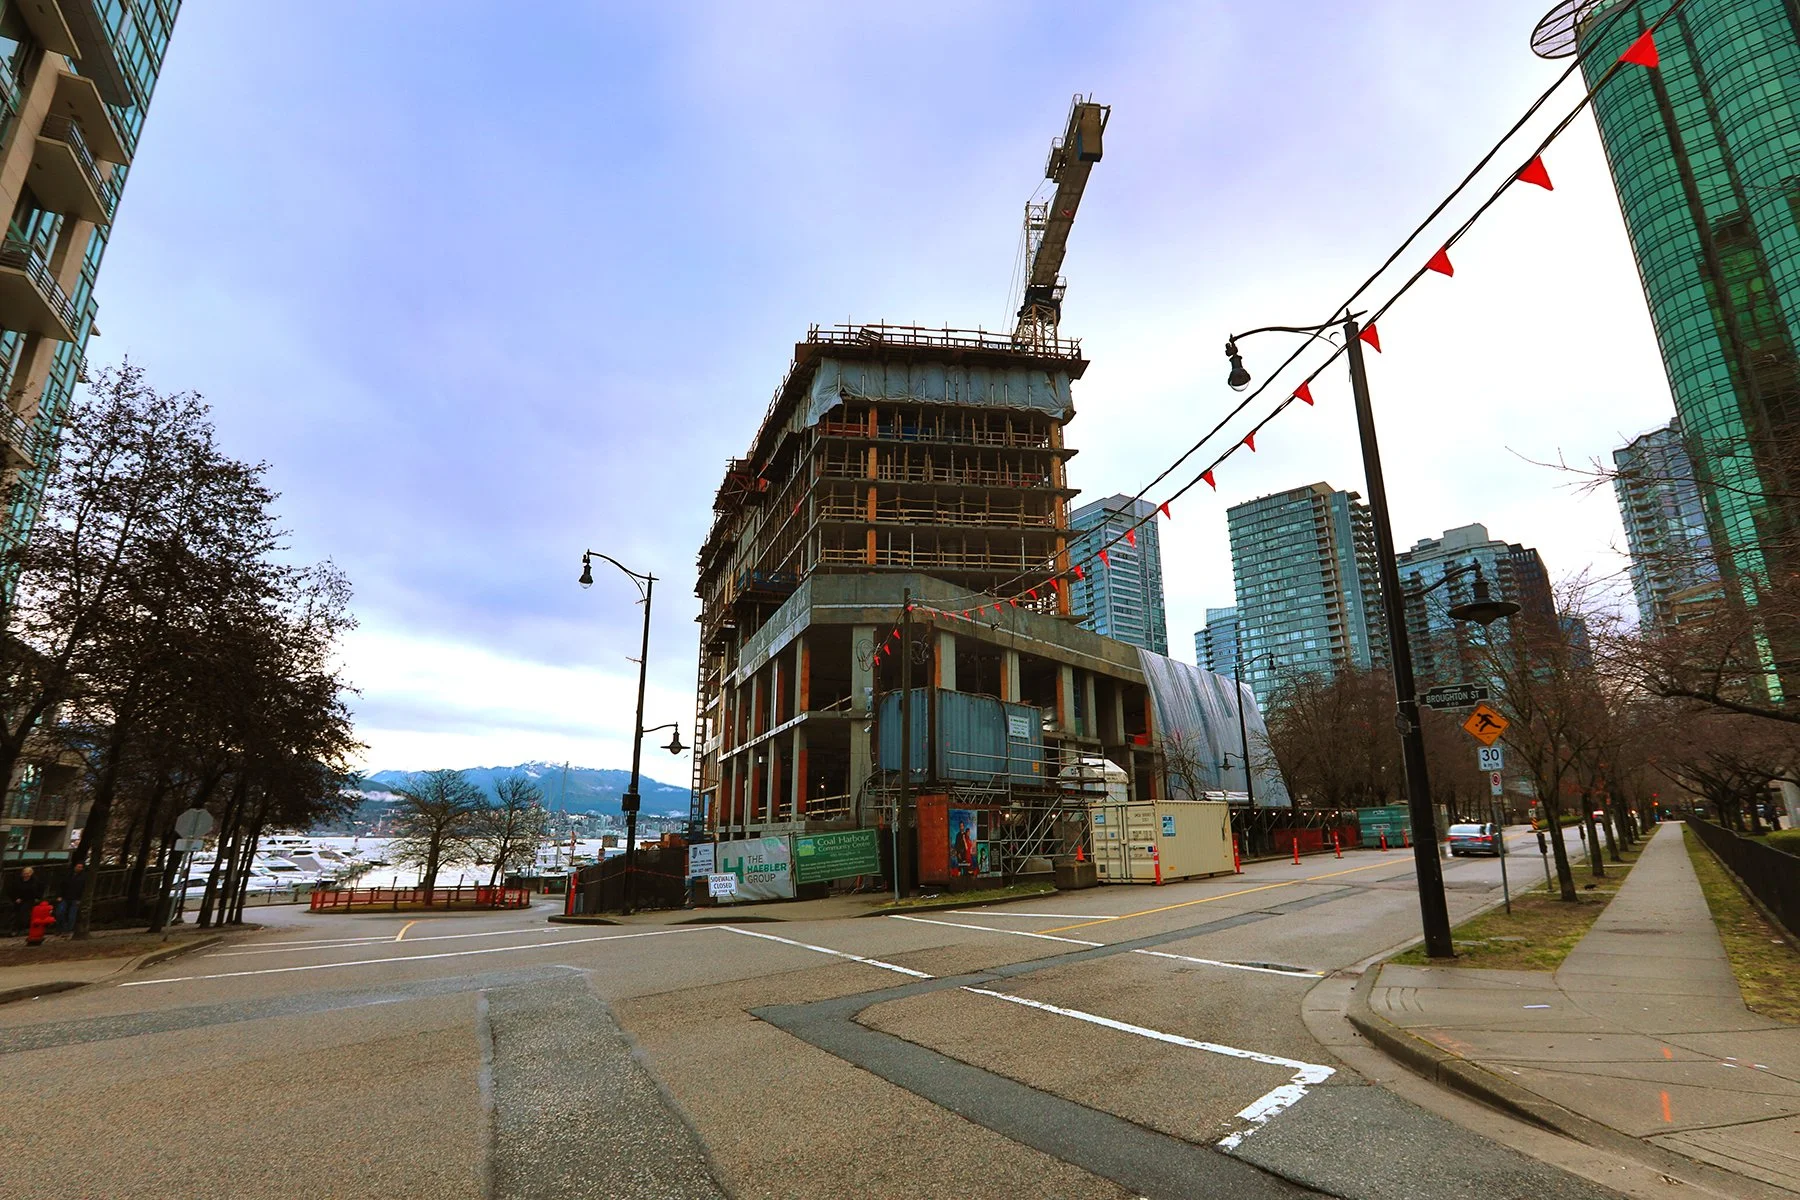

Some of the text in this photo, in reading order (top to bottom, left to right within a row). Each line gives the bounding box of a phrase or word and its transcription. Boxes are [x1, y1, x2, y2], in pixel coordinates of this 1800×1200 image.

[1426, 690, 1479, 703] BROUGHTON ST
[1482, 749, 1499, 761] 30
[817, 834, 870, 846] Coal Harbour
[818, 844, 850, 852] Community
[747, 854, 763, 863] THE
[747, 862, 787, 873] HAEBLER
[747, 873, 776, 883] GROUP
[713, 882, 732, 890] CLOSED
